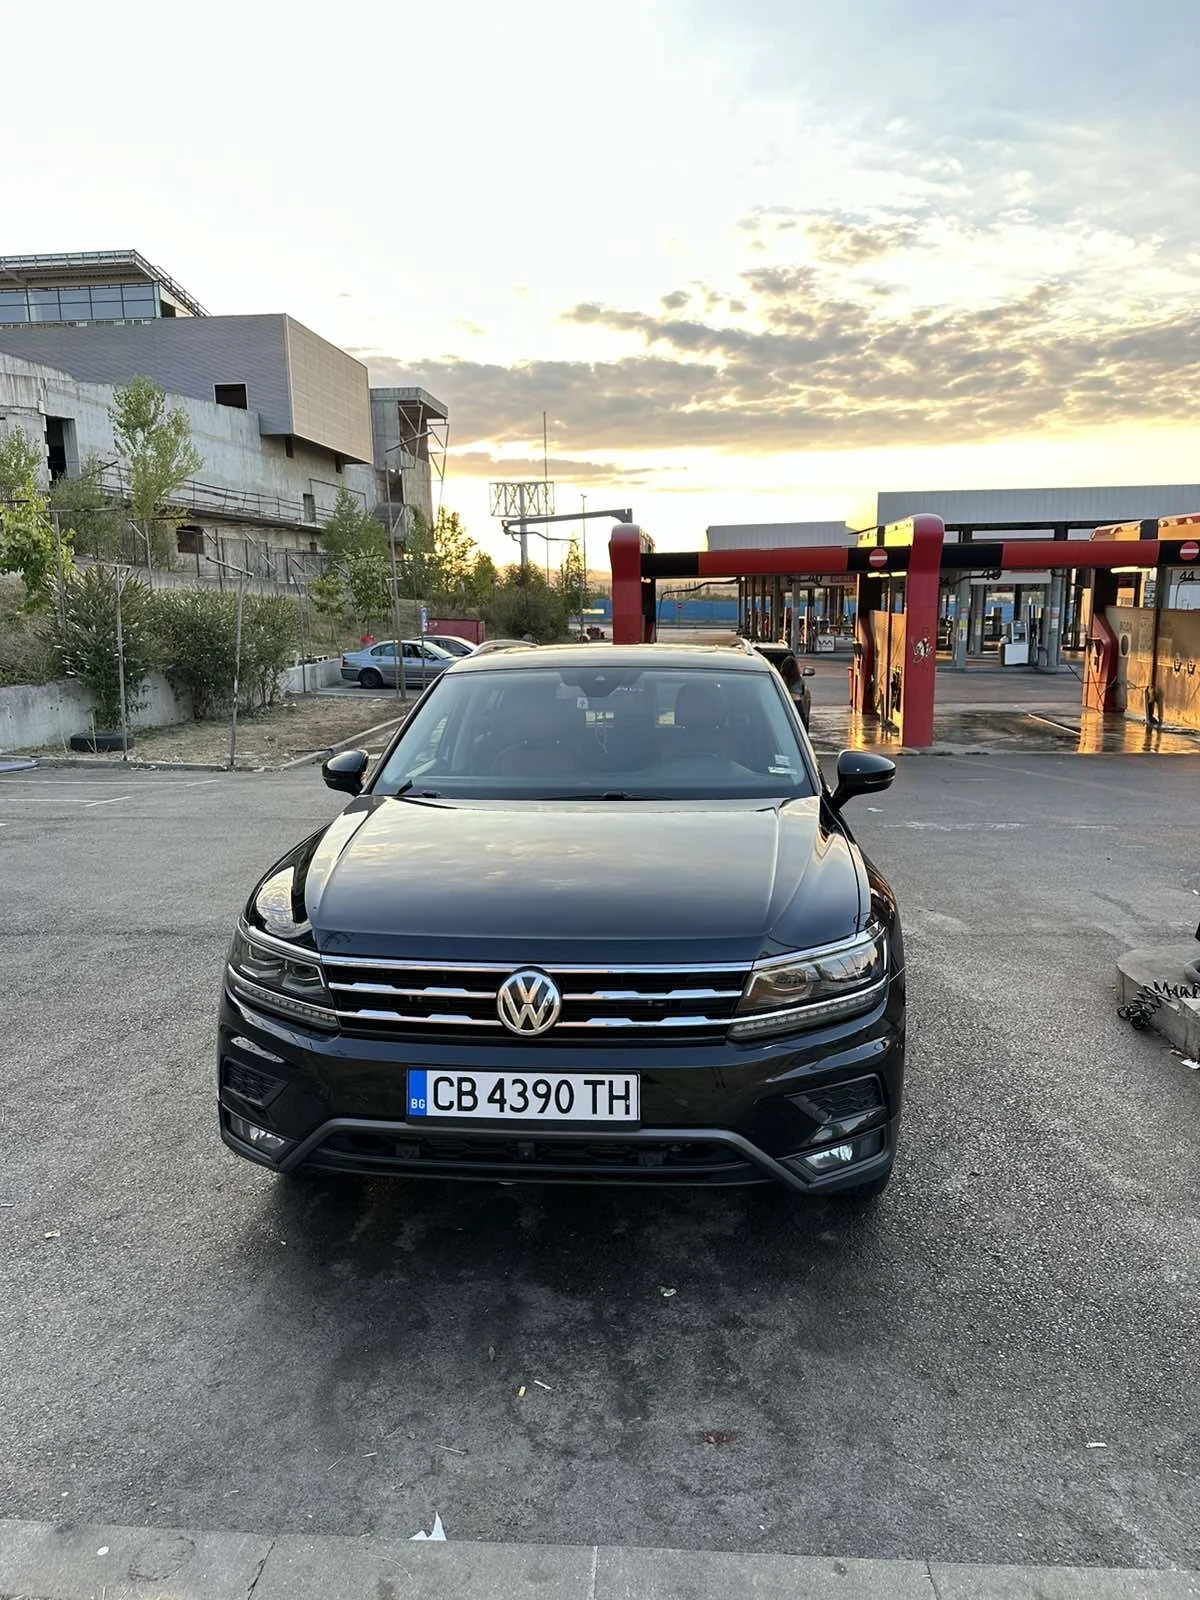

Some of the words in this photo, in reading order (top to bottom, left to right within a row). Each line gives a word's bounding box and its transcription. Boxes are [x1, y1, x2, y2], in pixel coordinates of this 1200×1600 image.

[1179, 570, 1195, 581] 44
[432, 1076, 479, 1112] CB
[487, 1077, 575, 1115] 4390
[583, 1079, 631, 1116] TH
[410, 1098, 426, 1110] BG
